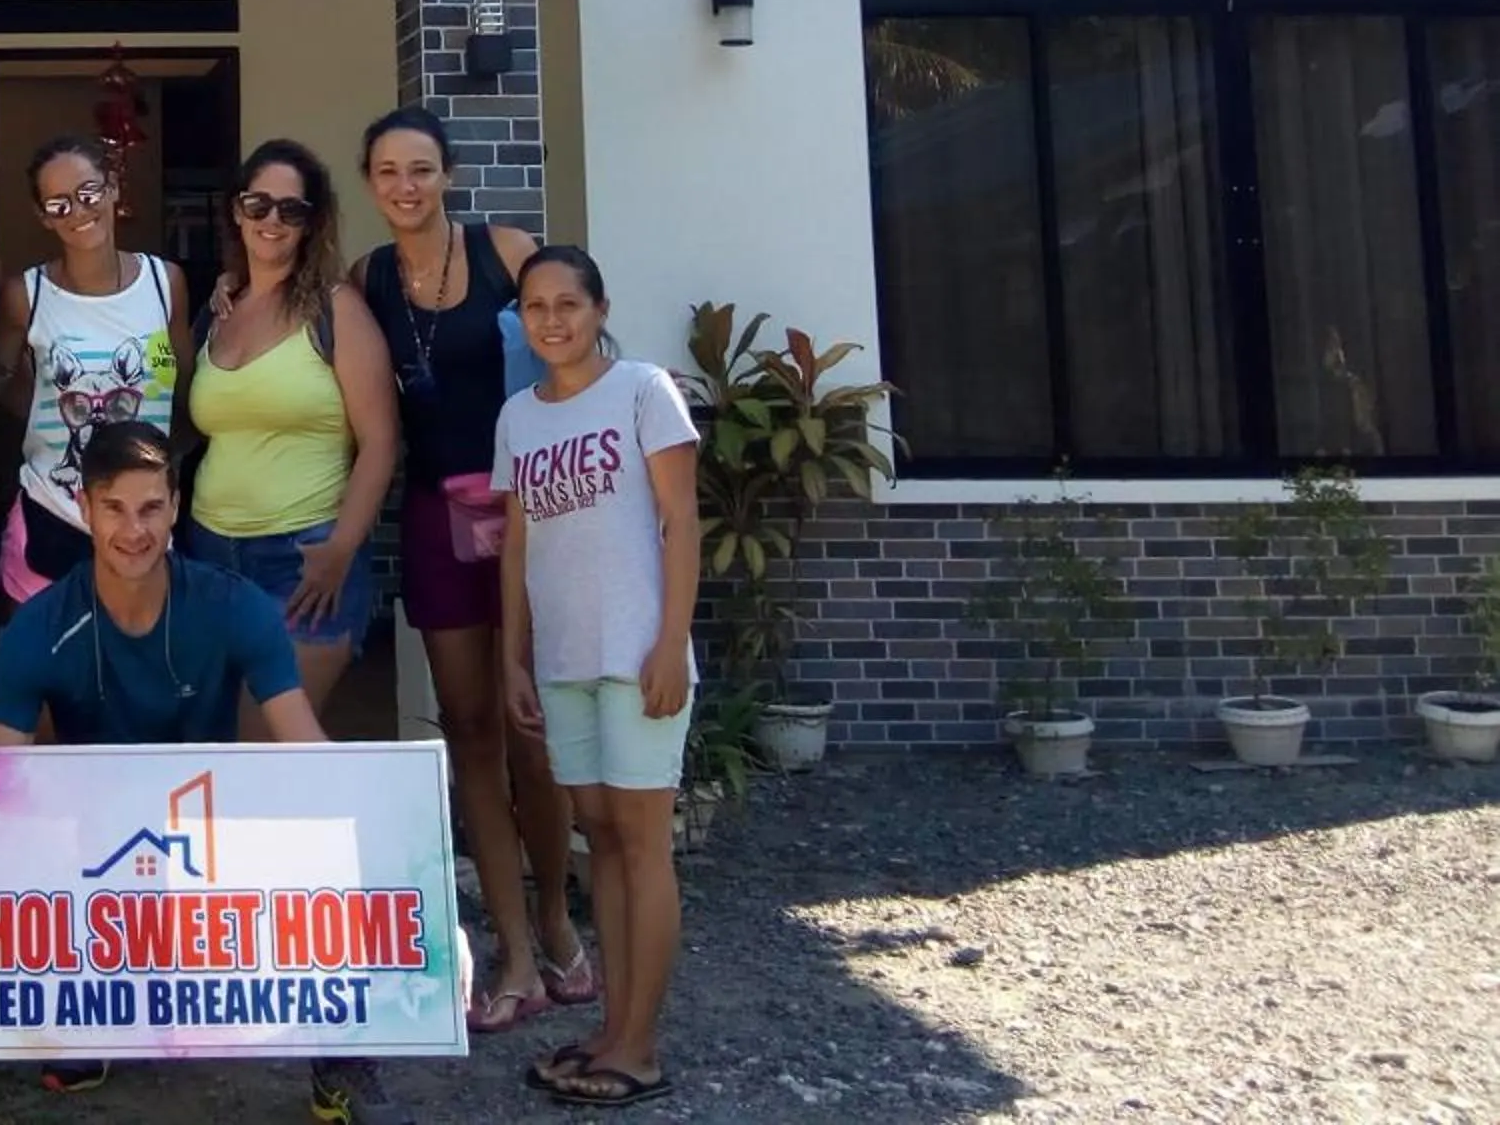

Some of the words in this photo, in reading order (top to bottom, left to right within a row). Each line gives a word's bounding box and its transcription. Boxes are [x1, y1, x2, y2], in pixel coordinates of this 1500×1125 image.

[88, 890, 264, 971] SWEET
[271, 889, 425, 970] HOME
[56, 979, 135, 1026] AND
[148, 978, 371, 1026] BREAKFAST
